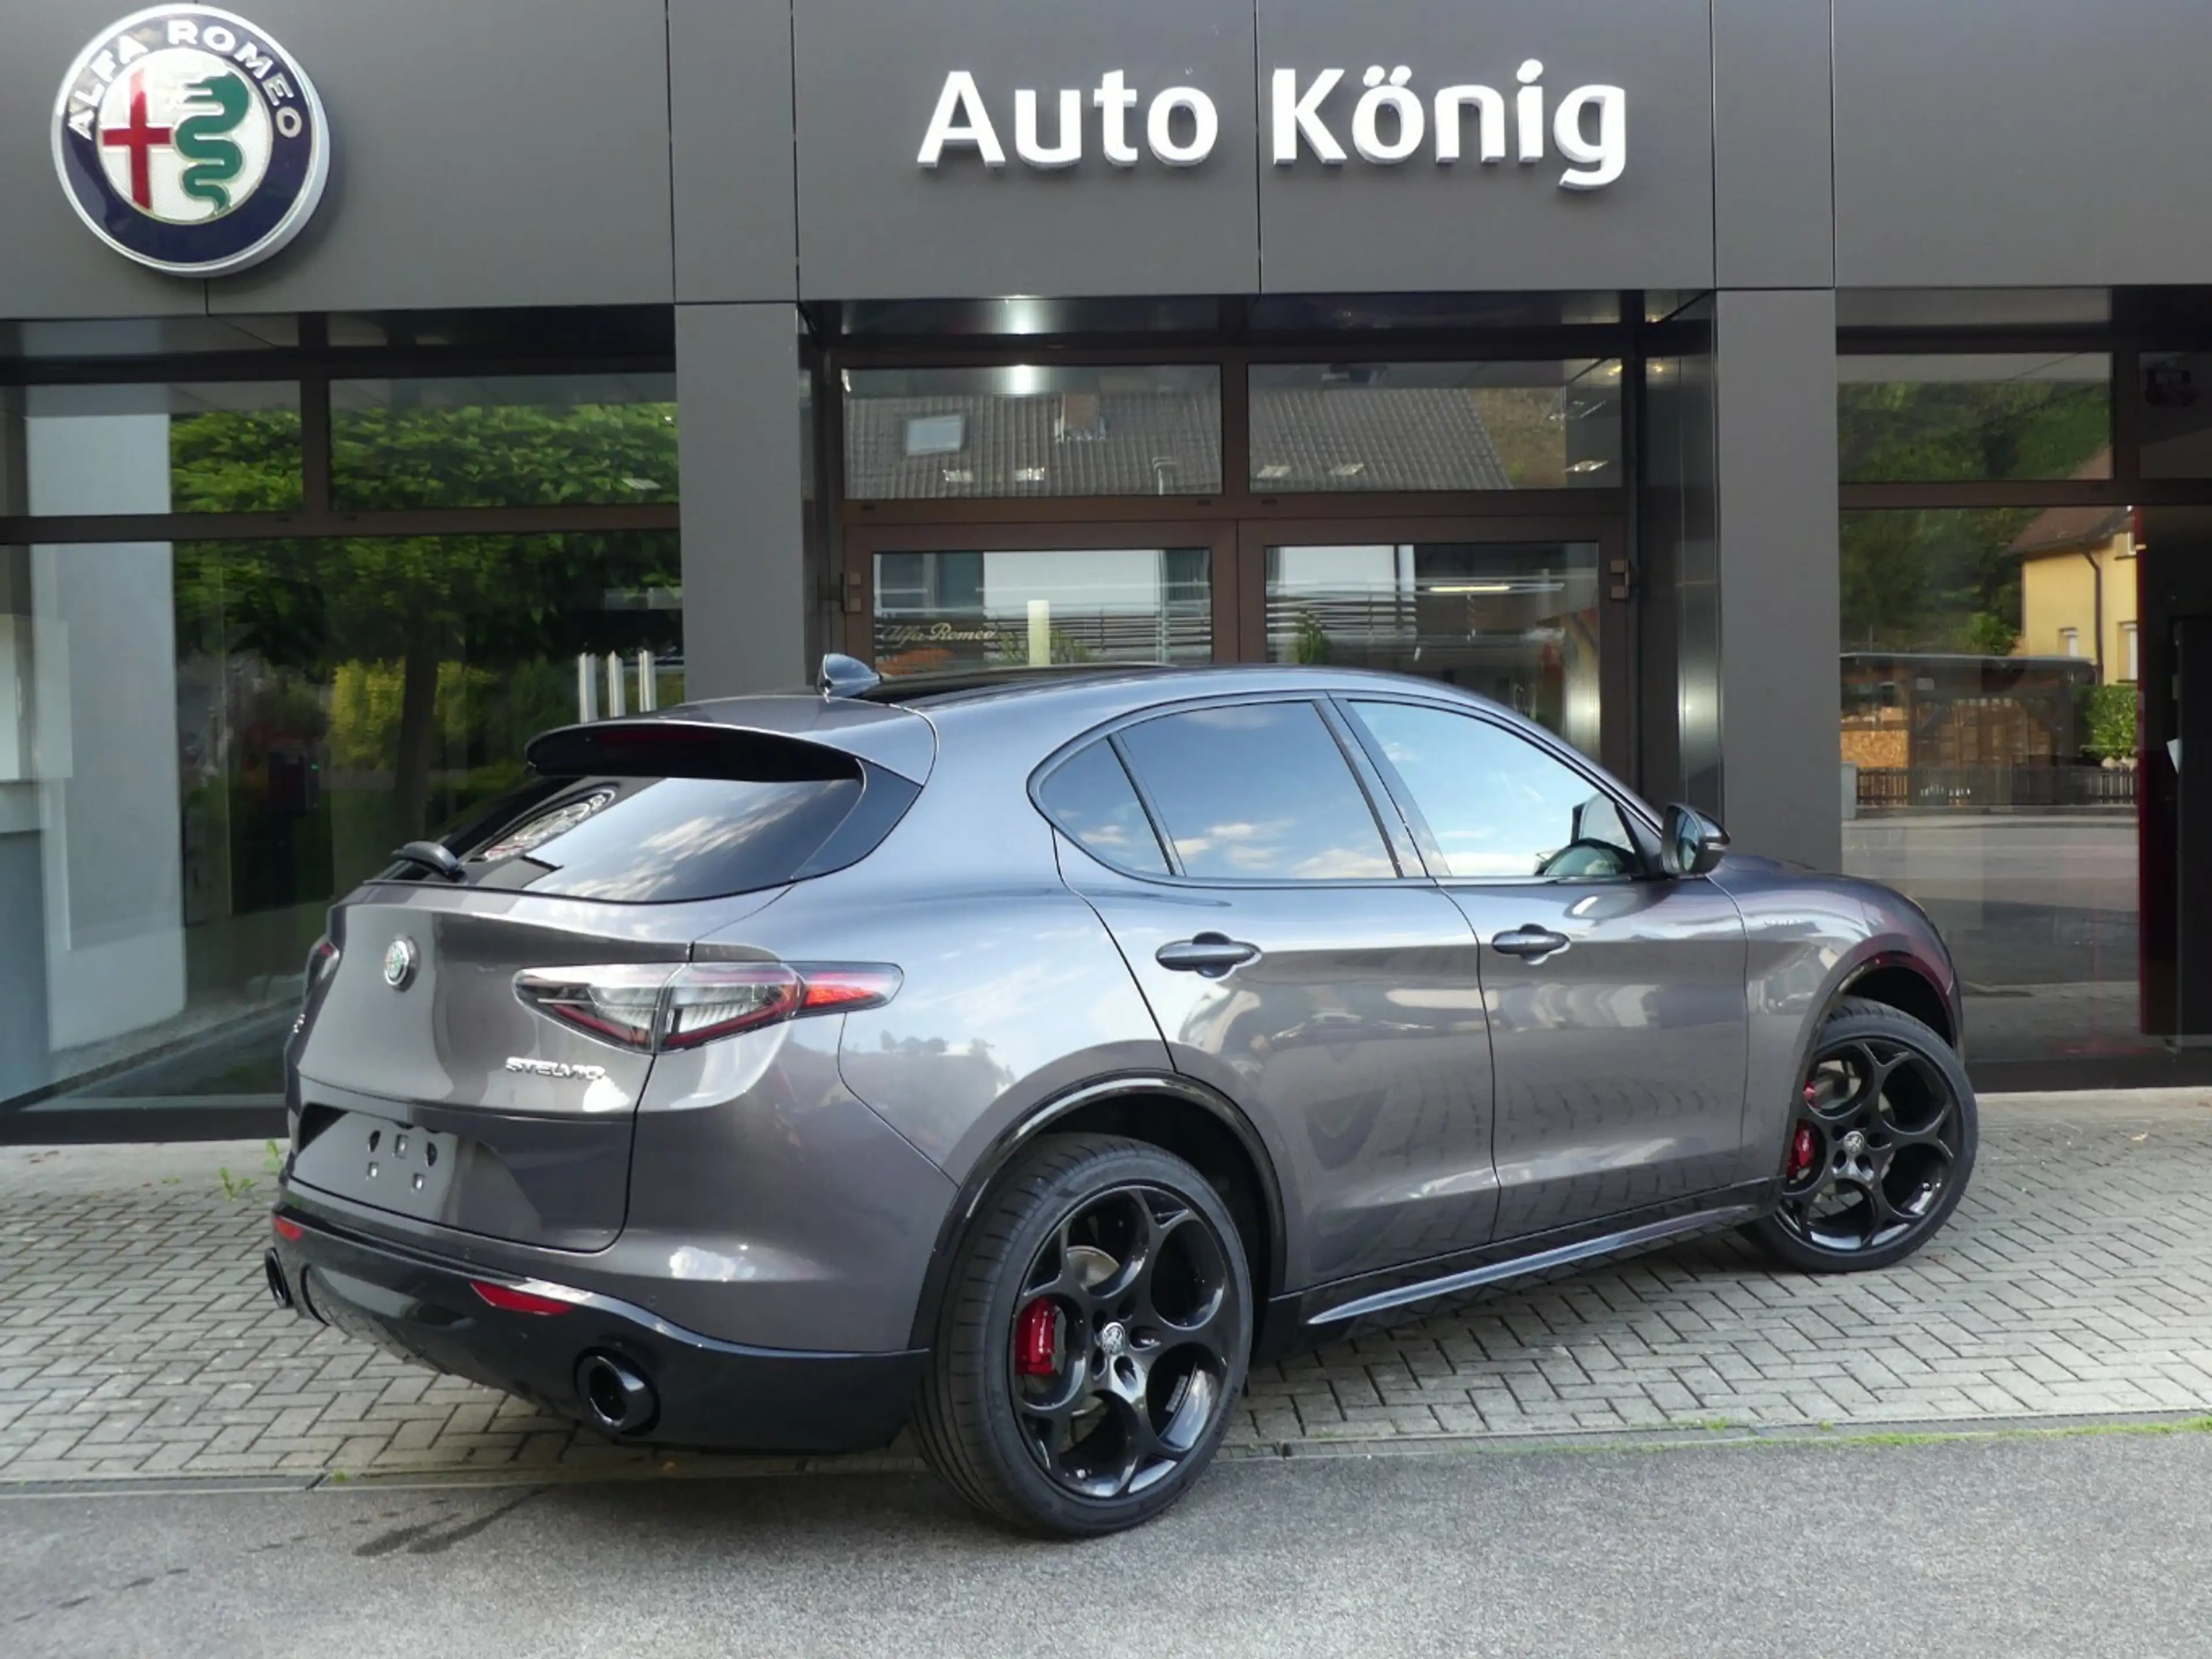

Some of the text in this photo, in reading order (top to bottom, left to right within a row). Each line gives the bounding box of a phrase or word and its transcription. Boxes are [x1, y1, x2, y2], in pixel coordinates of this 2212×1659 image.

[67, 19, 303, 141] ALFA ROMEO
[917, 58, 1627, 190] Auto König
[928, 622, 998, 641] Romeo
[505, 1056, 606, 1081] STELVIO
